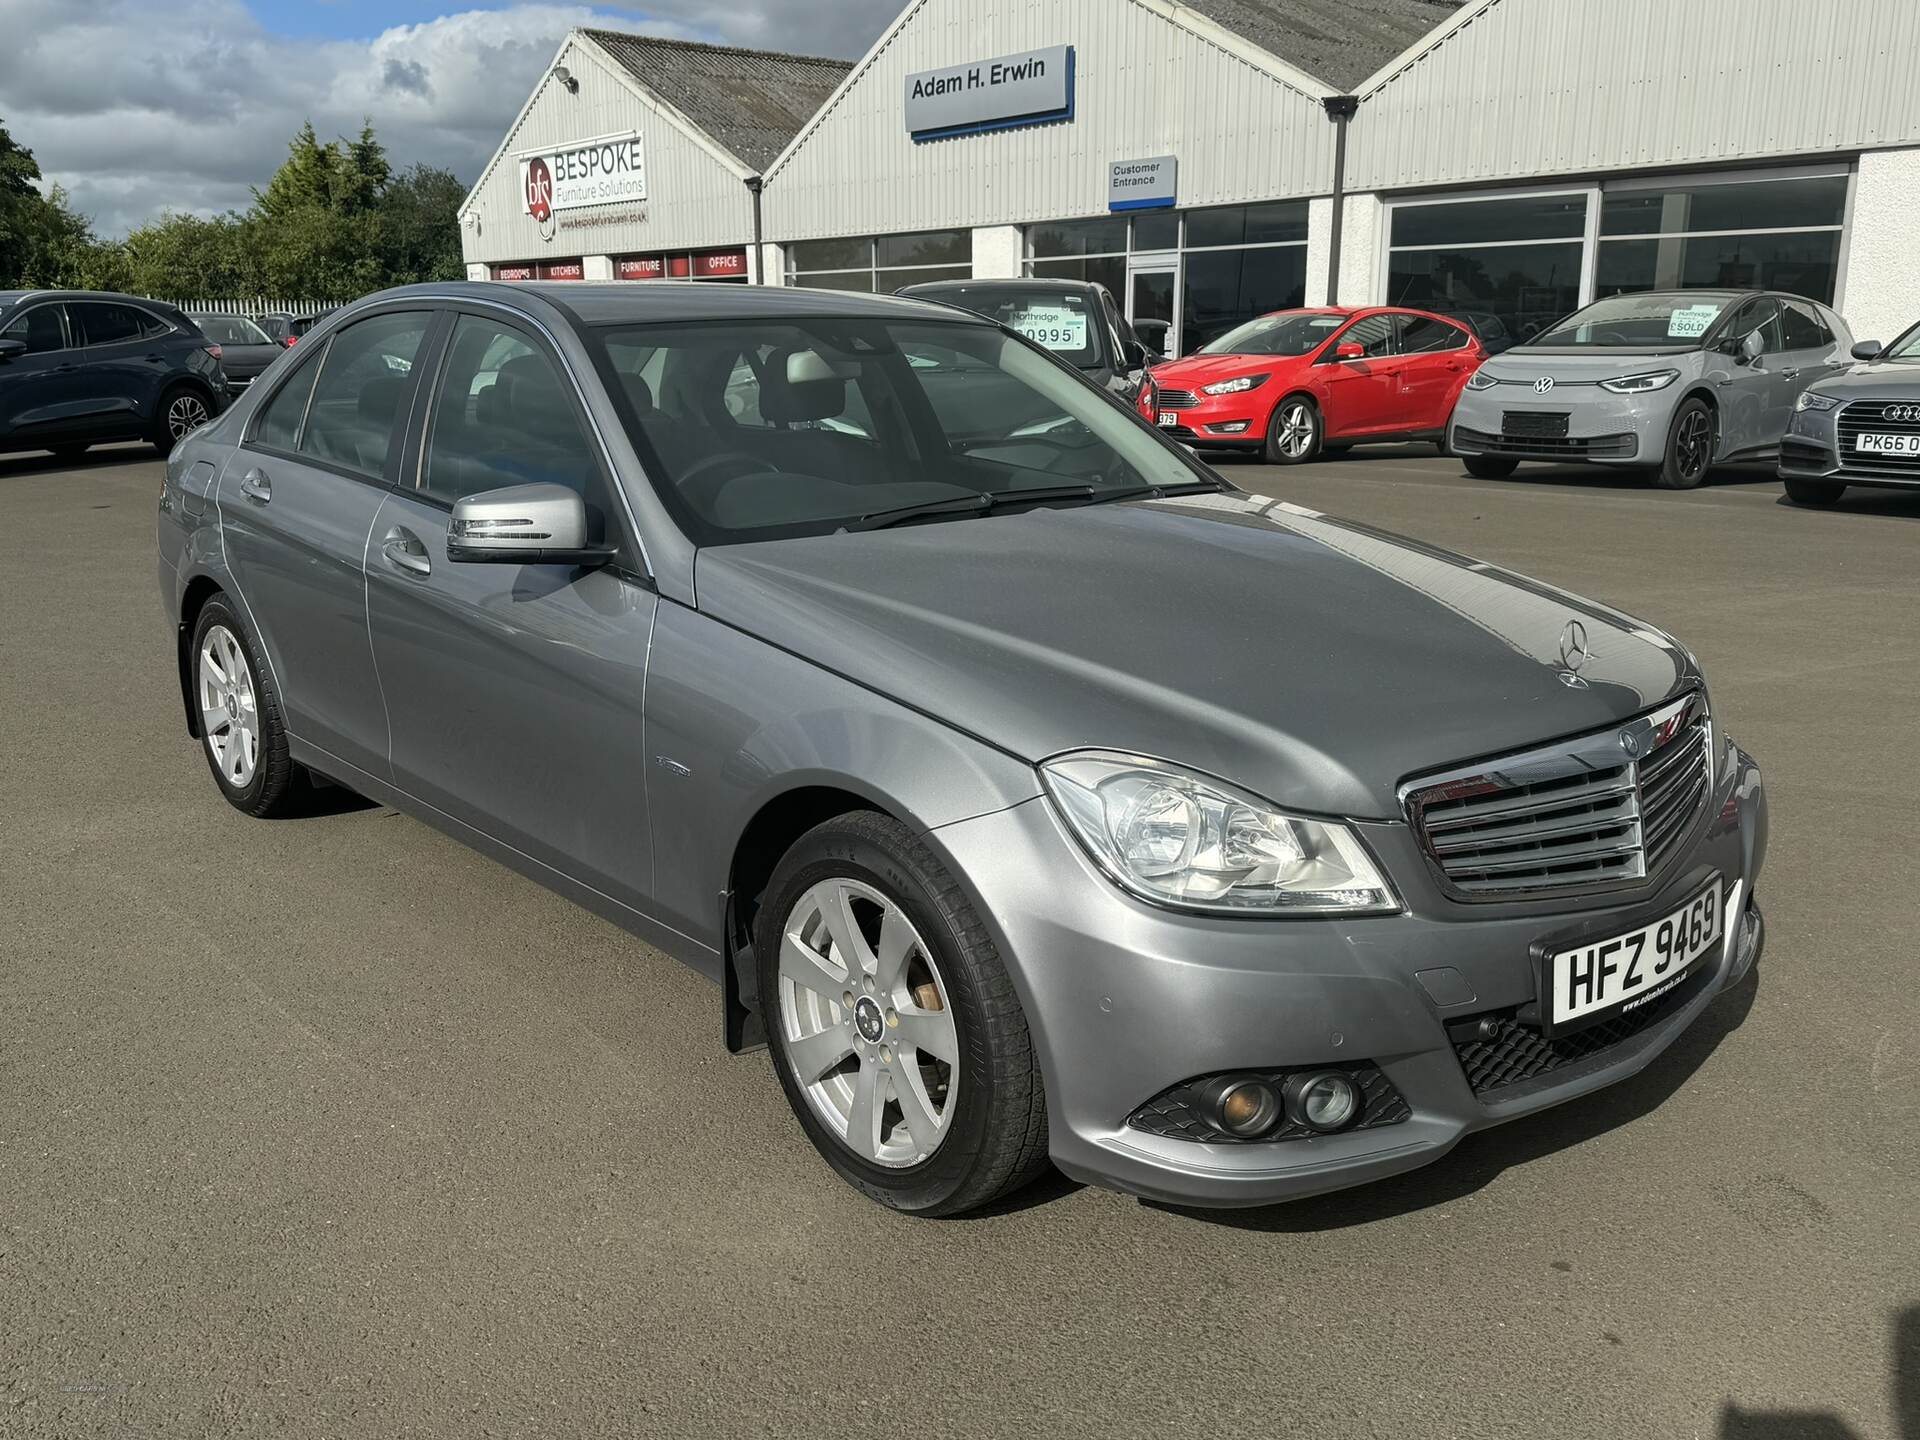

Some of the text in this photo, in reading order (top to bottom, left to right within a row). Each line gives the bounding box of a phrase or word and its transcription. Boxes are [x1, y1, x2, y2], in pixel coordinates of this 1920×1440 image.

[912, 57, 1045, 99] Adam H. Erwin
[555, 140, 641, 181] BESPOKE
[1113, 162, 1160, 176] Customer
[1113, 176, 1155, 188] Entrance
[557, 179, 643, 203] Furniture Solutions
[621, 260, 661, 272] FURNITURE
[709, 255, 738, 268] OFFICE
[500, 268, 531, 280] BEDROOMS
[550, 265, 580, 276] KITCHENS
[1013, 312, 1059, 323] Northridge
[1015, 329, 1072, 343] 0995
[1863, 435, 1905, 450] PK66
[1569, 889, 1716, 1010] HFZ 9469
